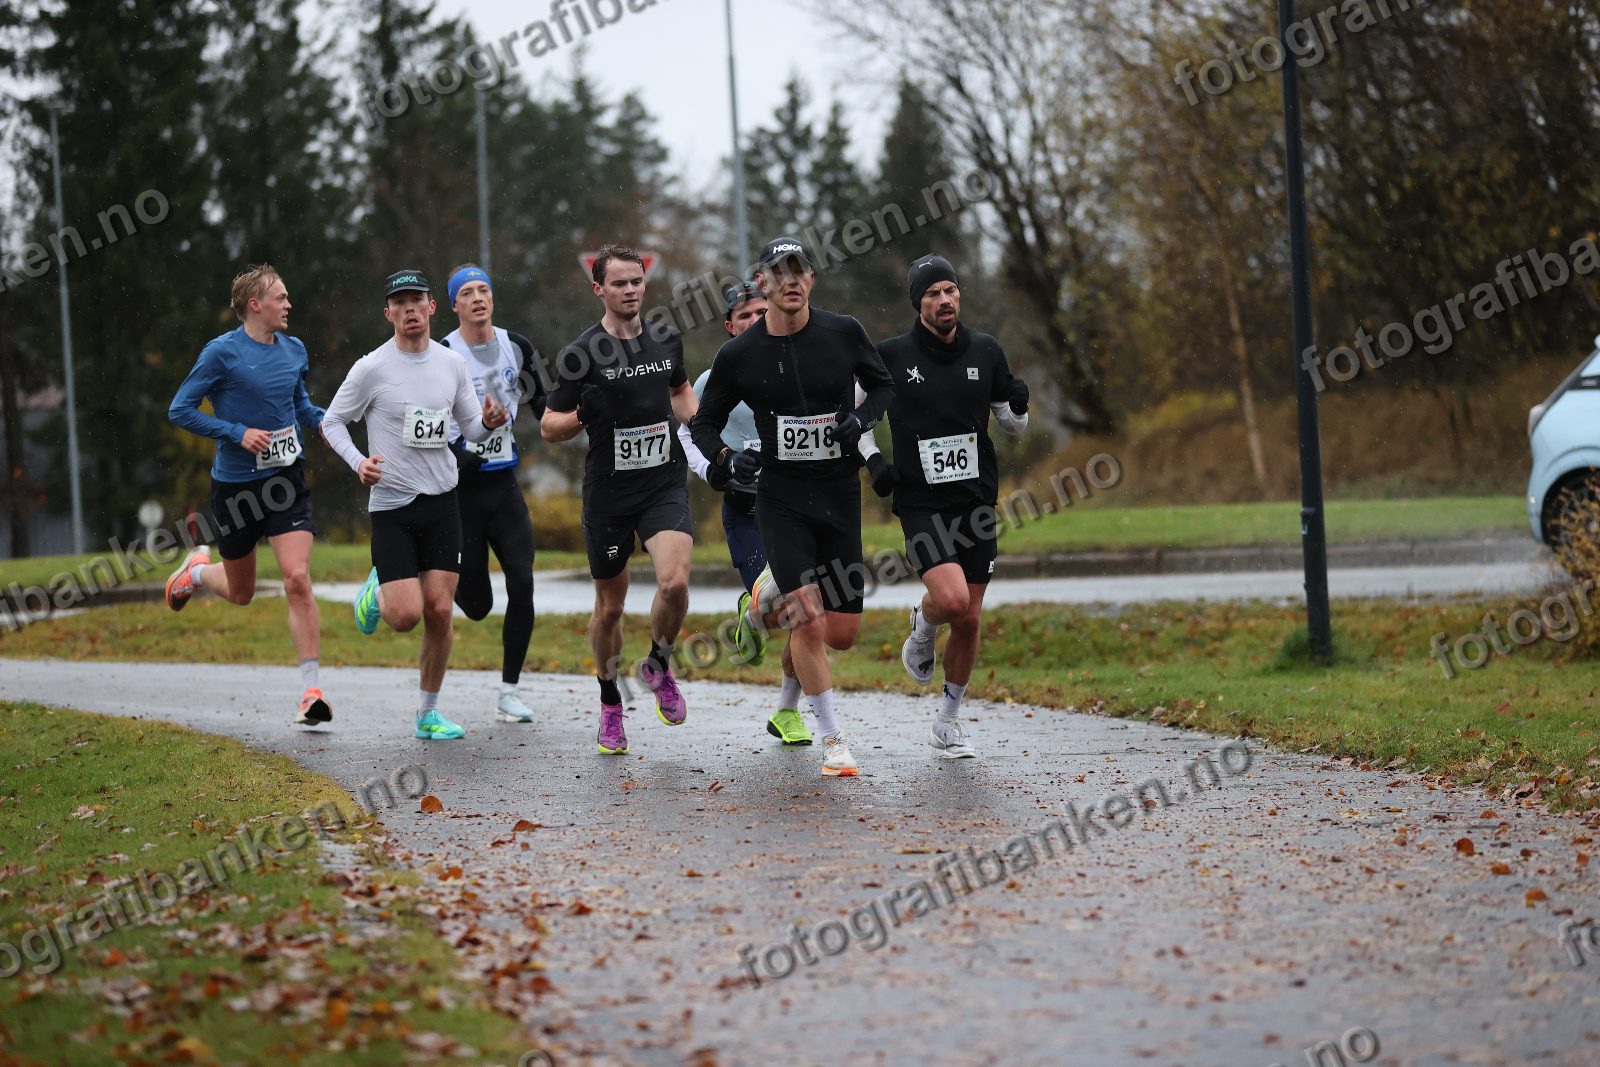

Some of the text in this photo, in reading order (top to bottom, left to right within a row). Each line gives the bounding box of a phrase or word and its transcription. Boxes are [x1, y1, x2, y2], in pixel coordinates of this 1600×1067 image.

[773, 243, 802, 254] HOKA
[393, 275, 418, 287] HOKA
[414, 419, 445, 439] 614
[783, 415, 835, 425] NORGESTESTEN
[620, 424, 667, 437] NORGESTESTEN
[783, 425, 835, 450] 9218
[261, 436, 297, 461] 9478
[476, 436, 502, 456] 548
[620, 433, 667, 459] 9177
[933, 448, 968, 473] 546
